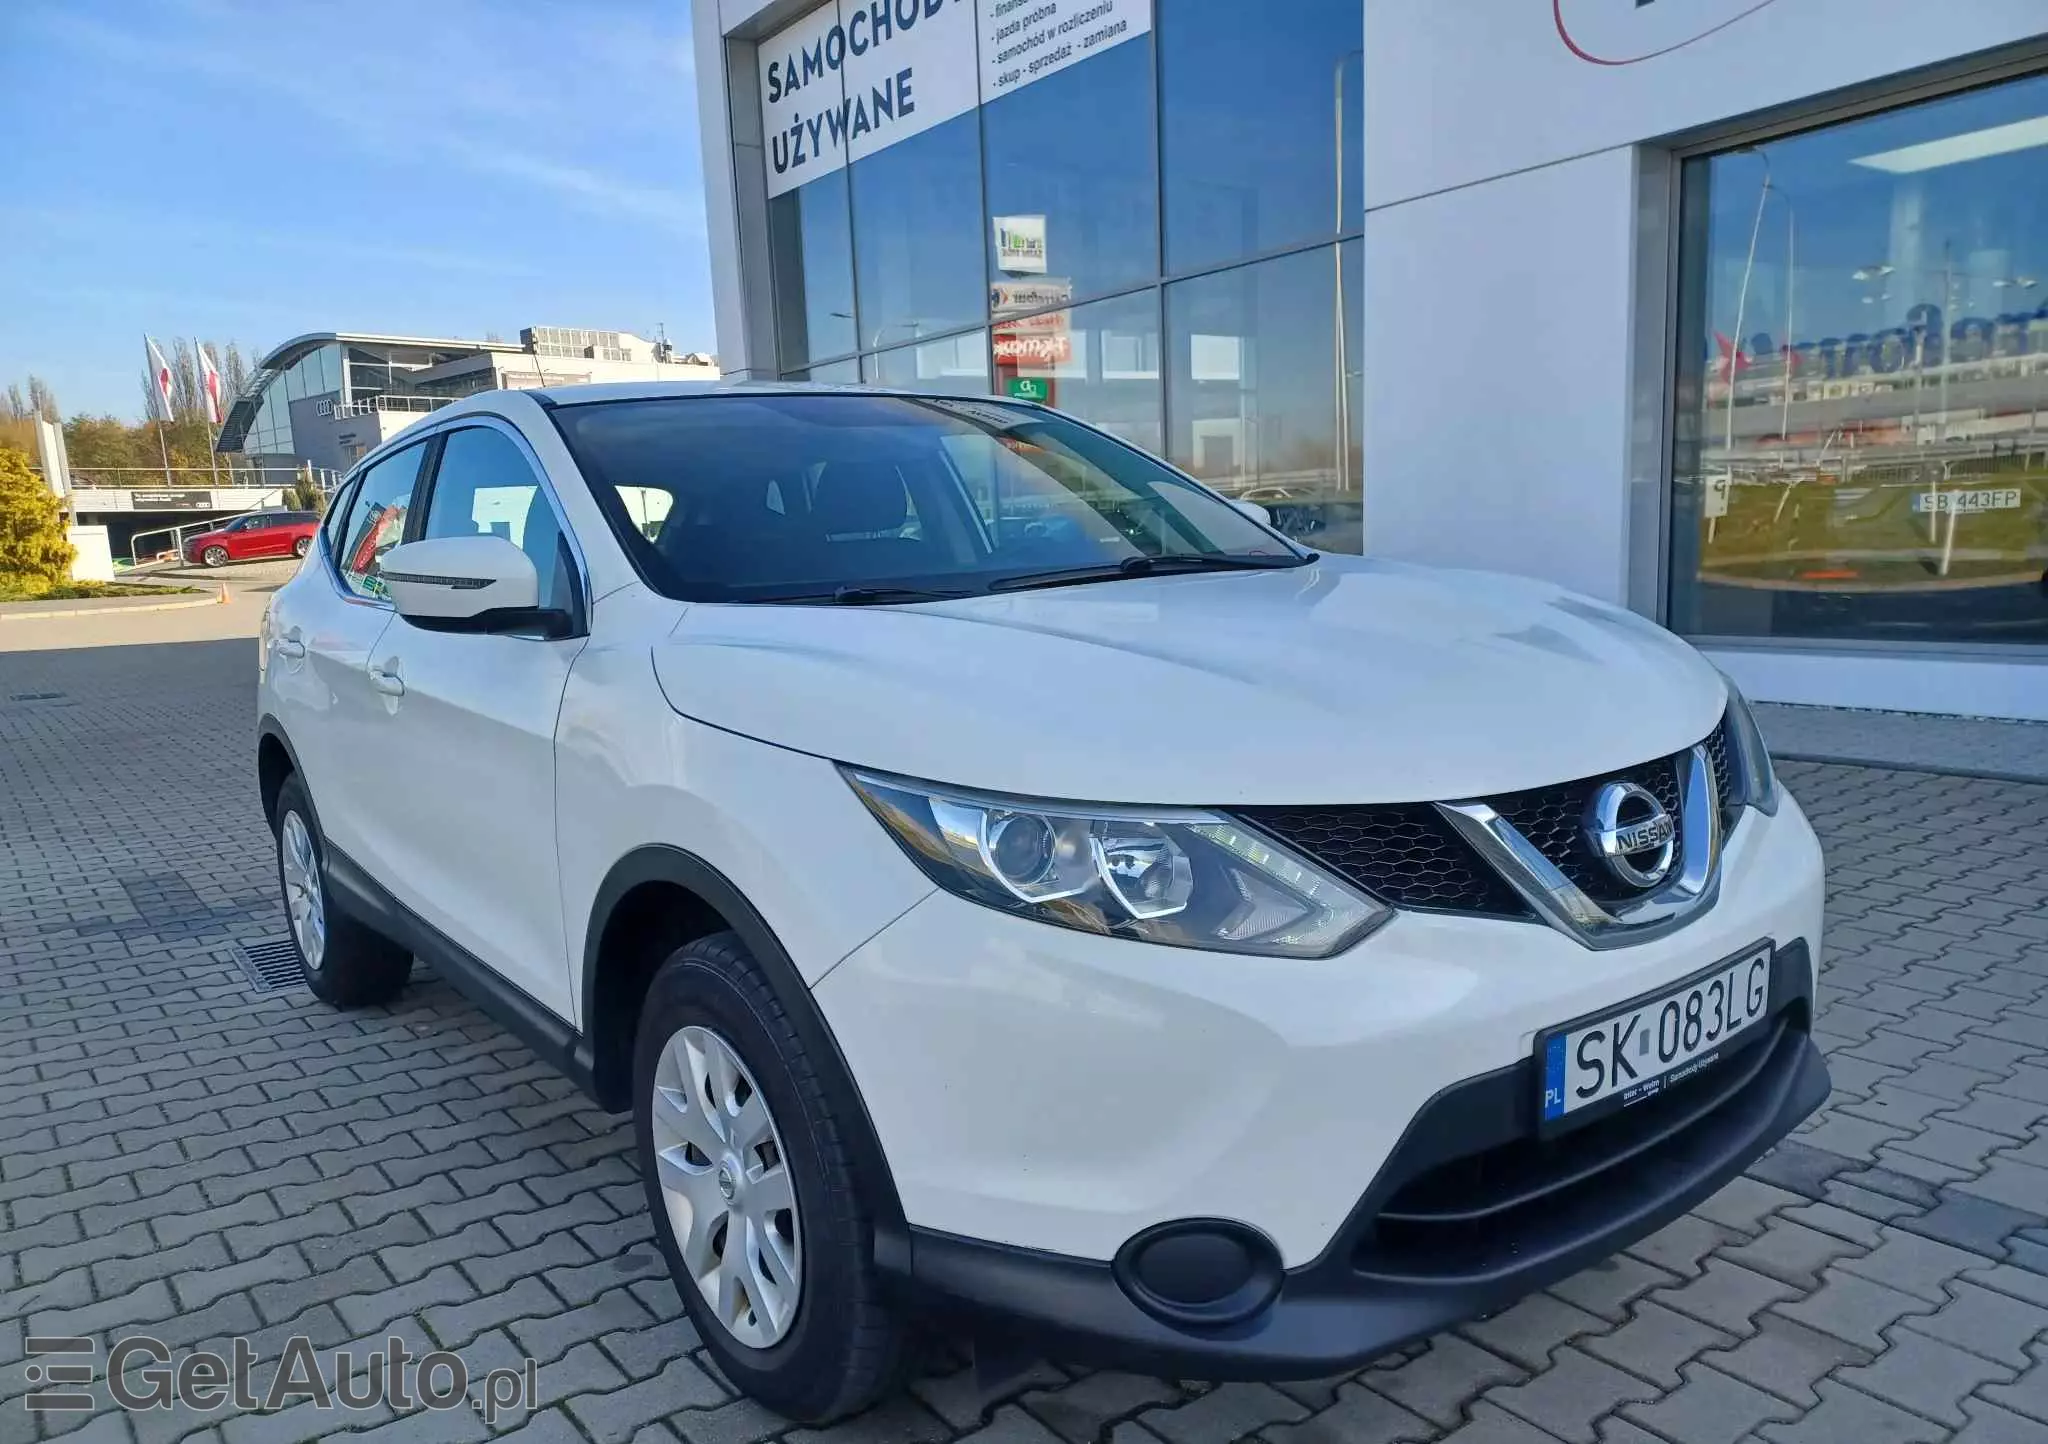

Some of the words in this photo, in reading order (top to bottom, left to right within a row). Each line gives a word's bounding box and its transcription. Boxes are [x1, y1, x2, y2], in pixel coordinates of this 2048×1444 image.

[768, 0, 961, 103] SAMOCHO
[996, 20, 1020, 44] jazda
[997, 29, 1045, 64] samochód
[1047, 27, 1056, 40] w
[1058, 1, 1113, 35] rozliczeniu
[998, 68, 1021, 87] skup
[1083, 20, 1127, 48] zamiana
[772, 67, 916, 174] UŻYWANE
[1924, 494, 1949, 510] SB
[1957, 490, 2017, 508] 443FP
[1616, 821, 1672, 850] NISSAN
[1575, 1013, 1641, 1099] SK
[1658, 957, 1766, 1063] 083LG
[1544, 1087, 1561, 1109] PL
